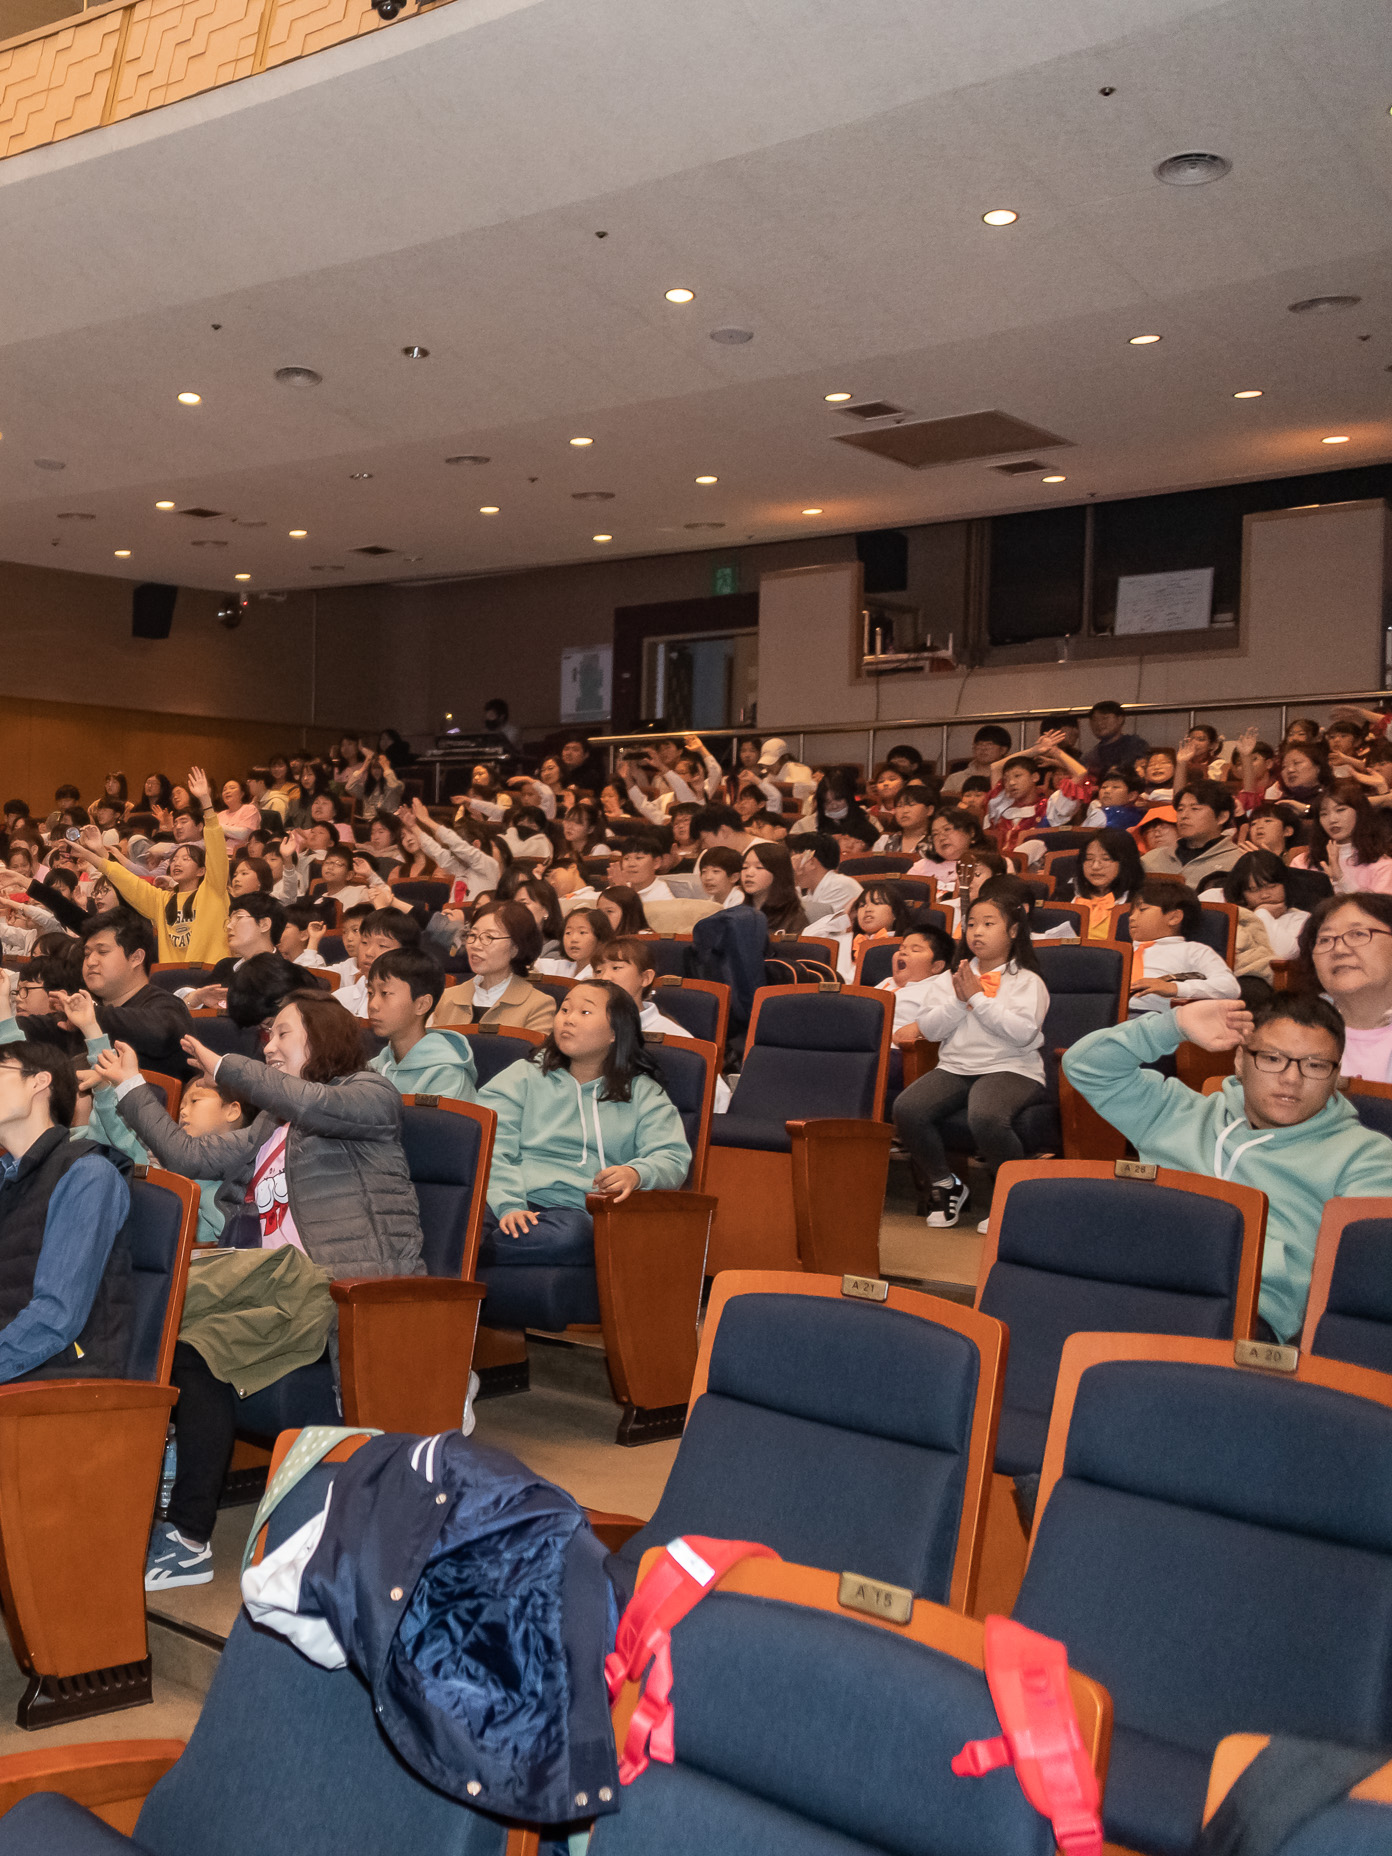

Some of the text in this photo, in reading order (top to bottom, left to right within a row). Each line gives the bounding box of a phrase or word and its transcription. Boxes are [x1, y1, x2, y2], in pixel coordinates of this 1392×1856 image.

[1124, 1164, 1130, 1172] A
[852, 1281, 874, 1292] A 21
[1249, 1347, 1282, 1362] A 20
[856, 1584, 892, 1607] A 15
